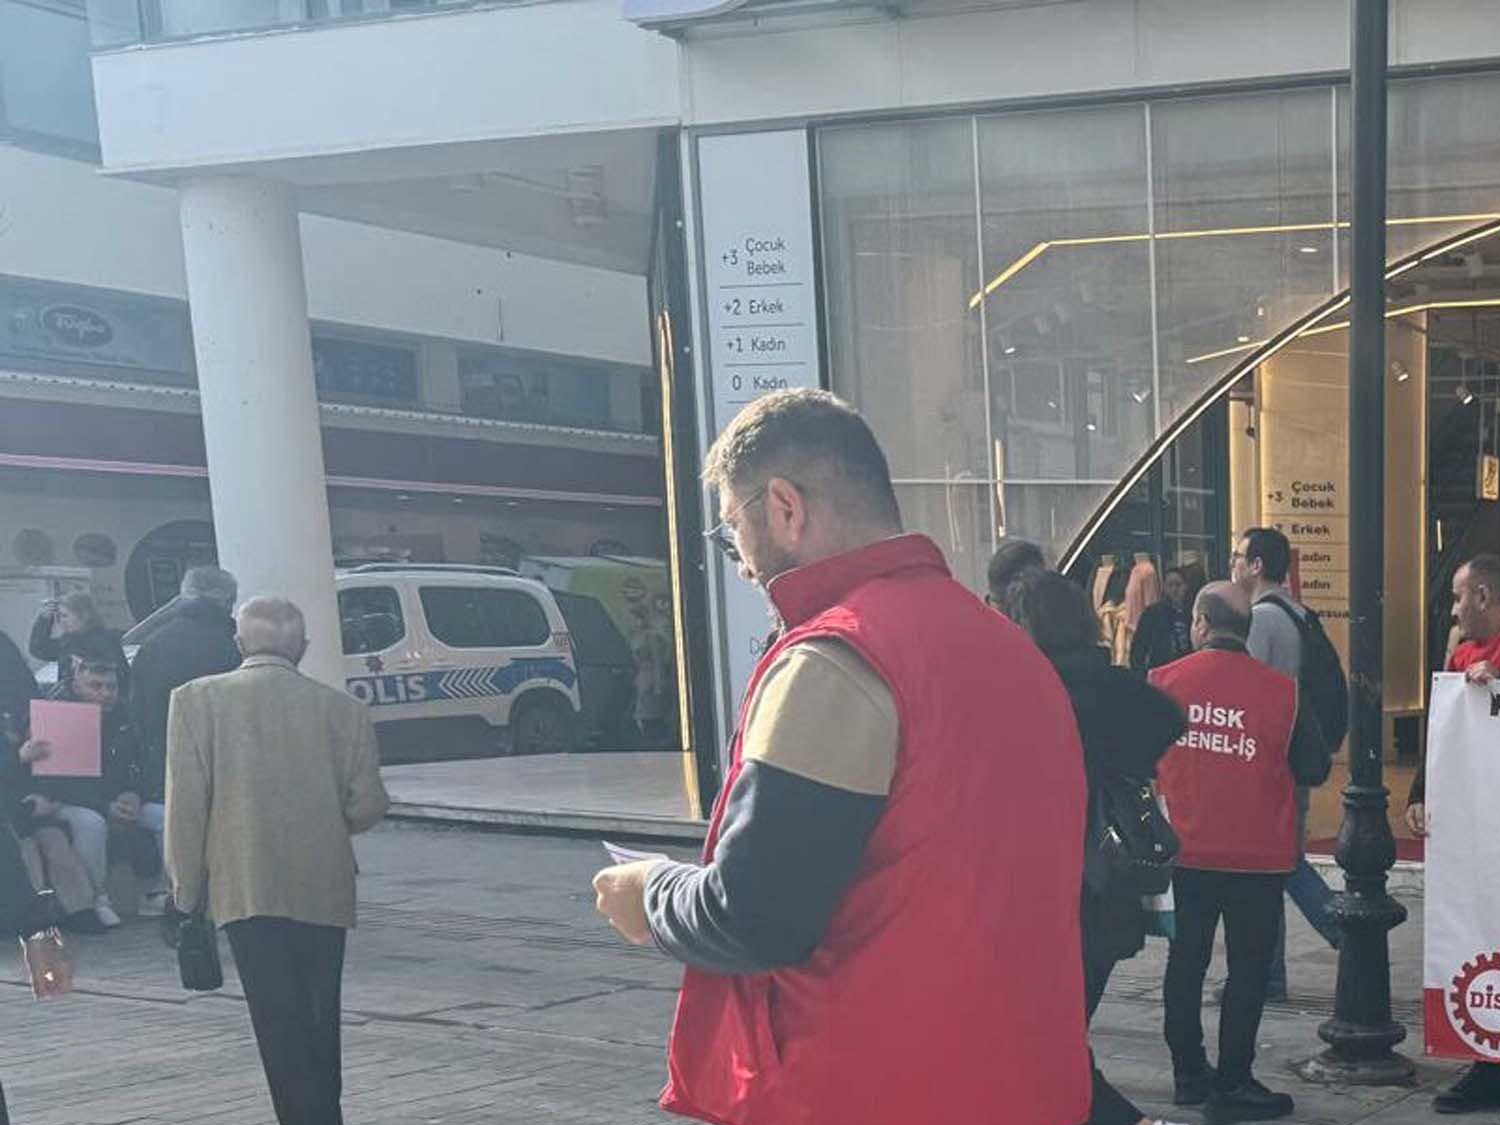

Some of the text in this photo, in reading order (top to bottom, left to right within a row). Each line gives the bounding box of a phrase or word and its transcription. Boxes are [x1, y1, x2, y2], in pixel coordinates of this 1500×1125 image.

[746, 238, 785, 256] Çocuk
[722, 250, 738, 266] +3
[747, 260, 785, 276] Bebek
[724, 299, 783, 315] +2 Erkek
[727, 336, 786, 352] +1 Kadın
[753, 376, 787, 390] Kadın
[1291, 481, 1336, 494] Çocuk
[1291, 498, 1335, 509] Bebek
[1291, 523, 1330, 534] Erkek
[1300, 552, 1331, 562] adın
[1301, 579, 1331, 590] adın
[1188, 702, 1245, 729] DİSK
